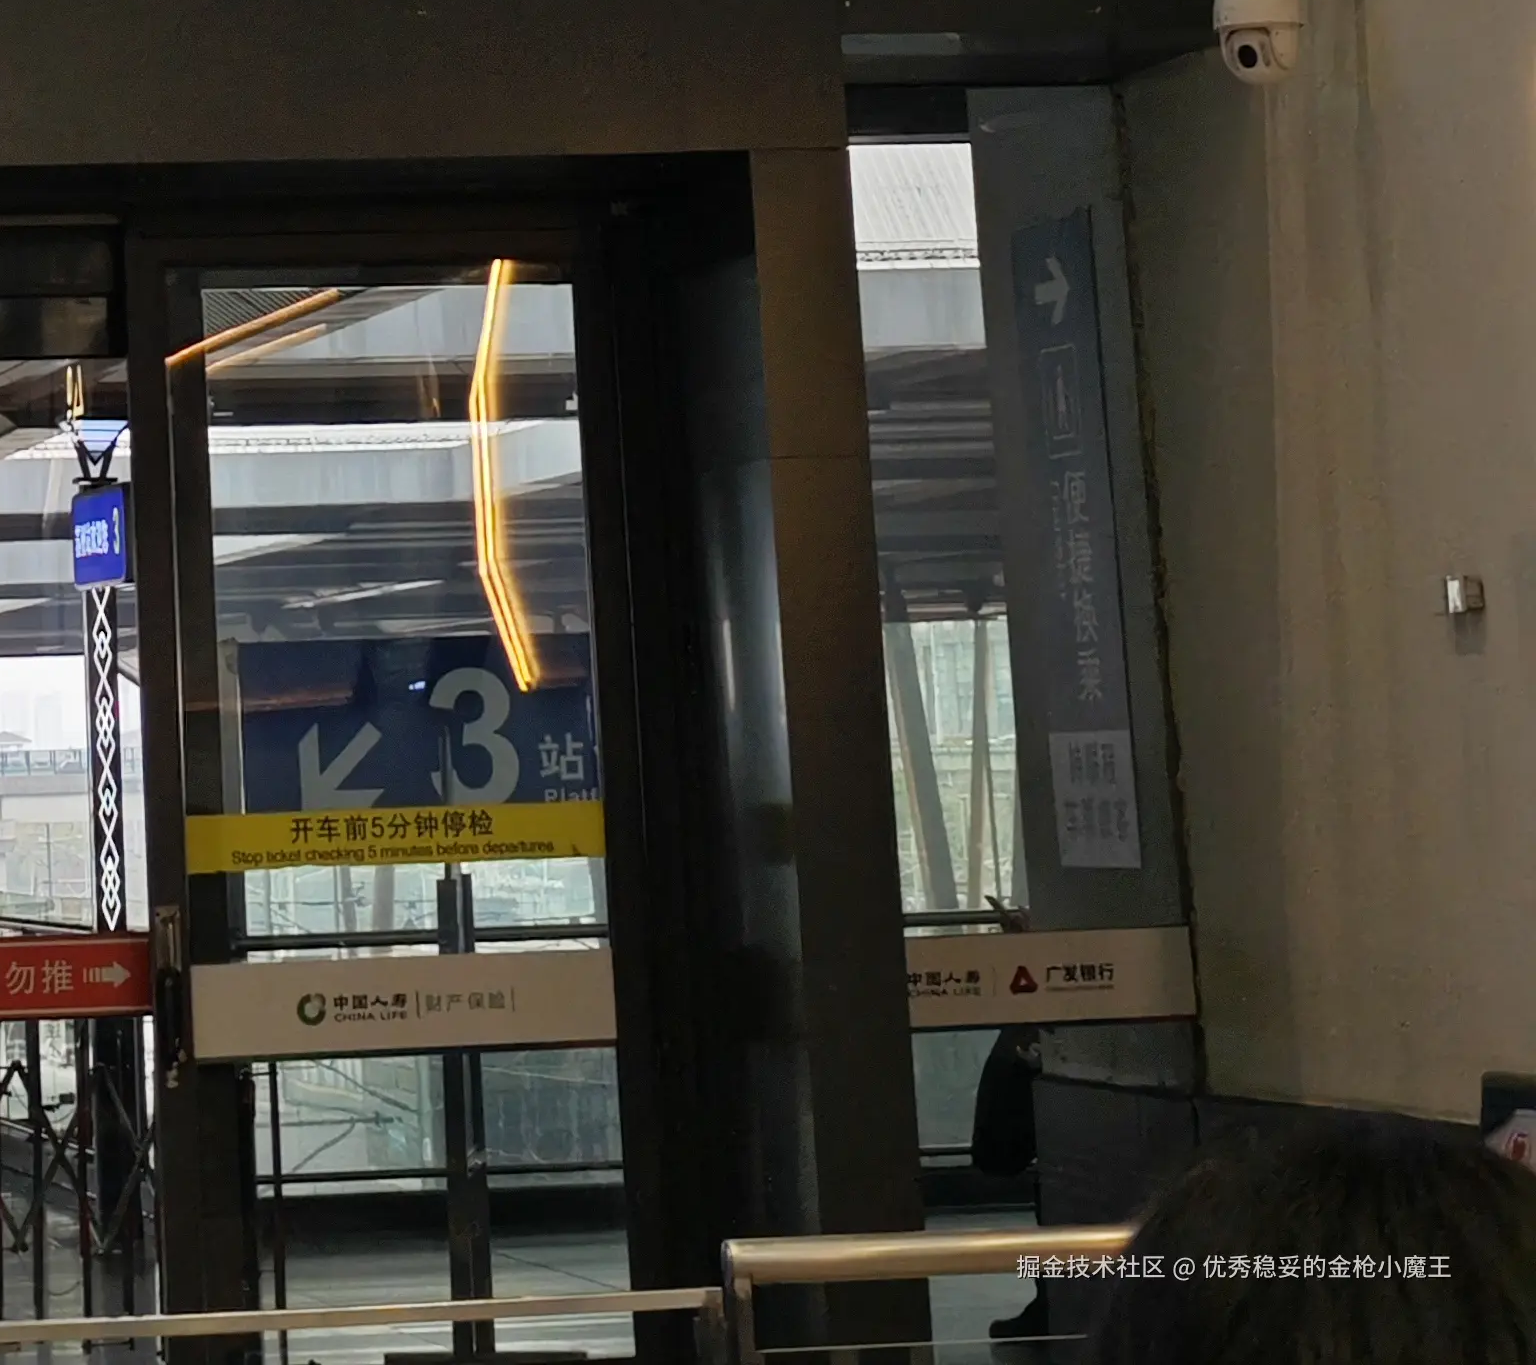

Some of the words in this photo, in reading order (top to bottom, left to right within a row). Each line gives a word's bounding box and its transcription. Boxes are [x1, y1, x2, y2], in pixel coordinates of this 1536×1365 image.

[428, 666, 520, 807] 3
[289, 808, 495, 844] 开车前5分钟停检
[230, 849, 264, 866] Stop
[265, 847, 302, 863] ticket
[304, 845, 366, 863] checking
[367, 844, 378, 860] 5
[379, 842, 435, 860] minutes
[435, 839, 481, 857] before
[332, 992, 408, 1011] 中国人寿
[333, 1011, 376, 1023] CHINA
